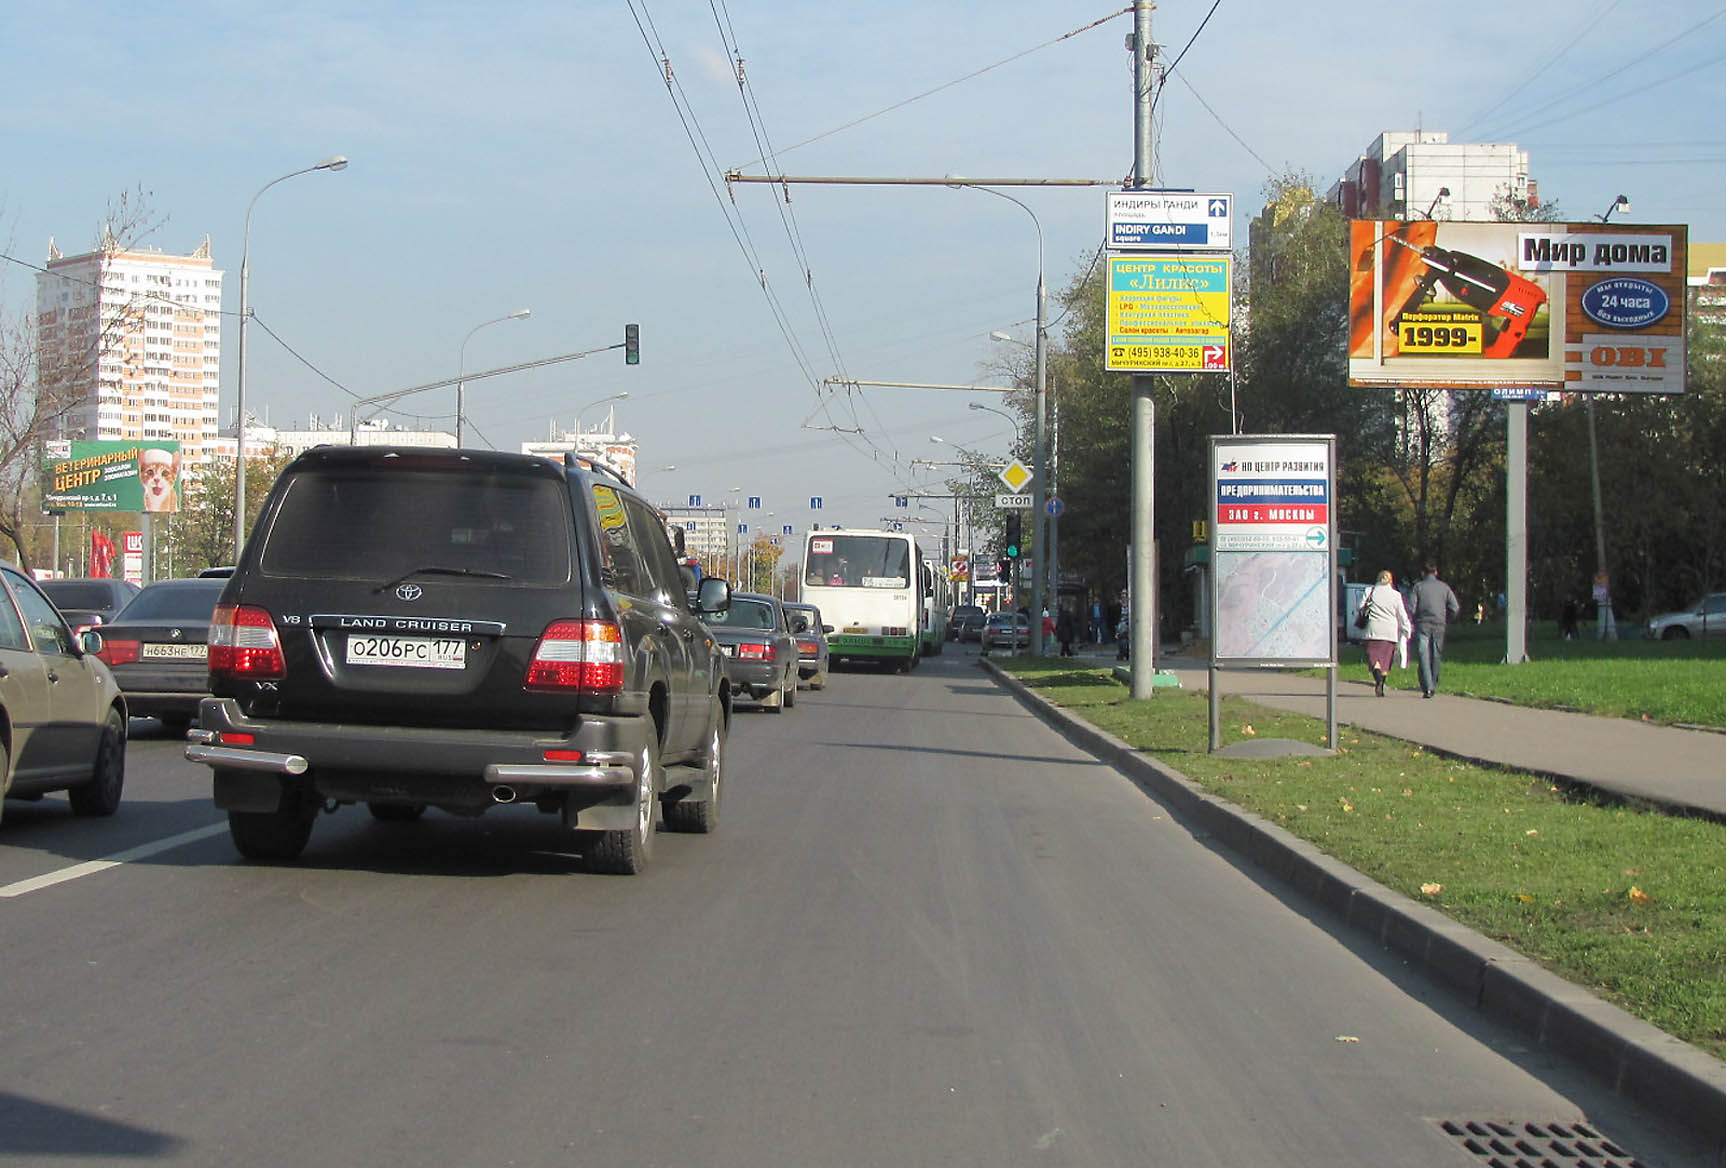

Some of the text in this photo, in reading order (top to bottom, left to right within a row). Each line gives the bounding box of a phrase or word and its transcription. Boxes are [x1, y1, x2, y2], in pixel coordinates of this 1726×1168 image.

[1114, 200, 1199, 209] ИНДИРЫ ГАНДИ
[1116, 224, 1187, 235] INDIRY GANDI
[1523, 238, 1667, 267] Мир дома
[1116, 264, 1223, 273] ЦЕНТР КРАСОТЫ
[1601, 295, 1650, 309] 24 часа
[1128, 346, 1199, 359] (495) 938-40-36
[1590, 346, 1667, 368] OBI
[55, 446, 138, 474] ВЕТЕРИНАРНЫЙ
[1241, 461, 1324, 473] НП ЦЕНТР РАЗВИТИЯ
[55, 469, 102, 492] ЦЕНТР
[1220, 484, 1325, 498] ПРЕДПРИНИМАТЕЛЬСТВА
[1228, 509, 1249, 520] ЗАО
[1269, 509, 1314, 520] МОСКВЫ
[283, 615, 301, 624] V8
[341, 618, 472, 632] LAND CRUISER
[433, 640, 460, 655] 177
[256, 682, 278, 691] VX
